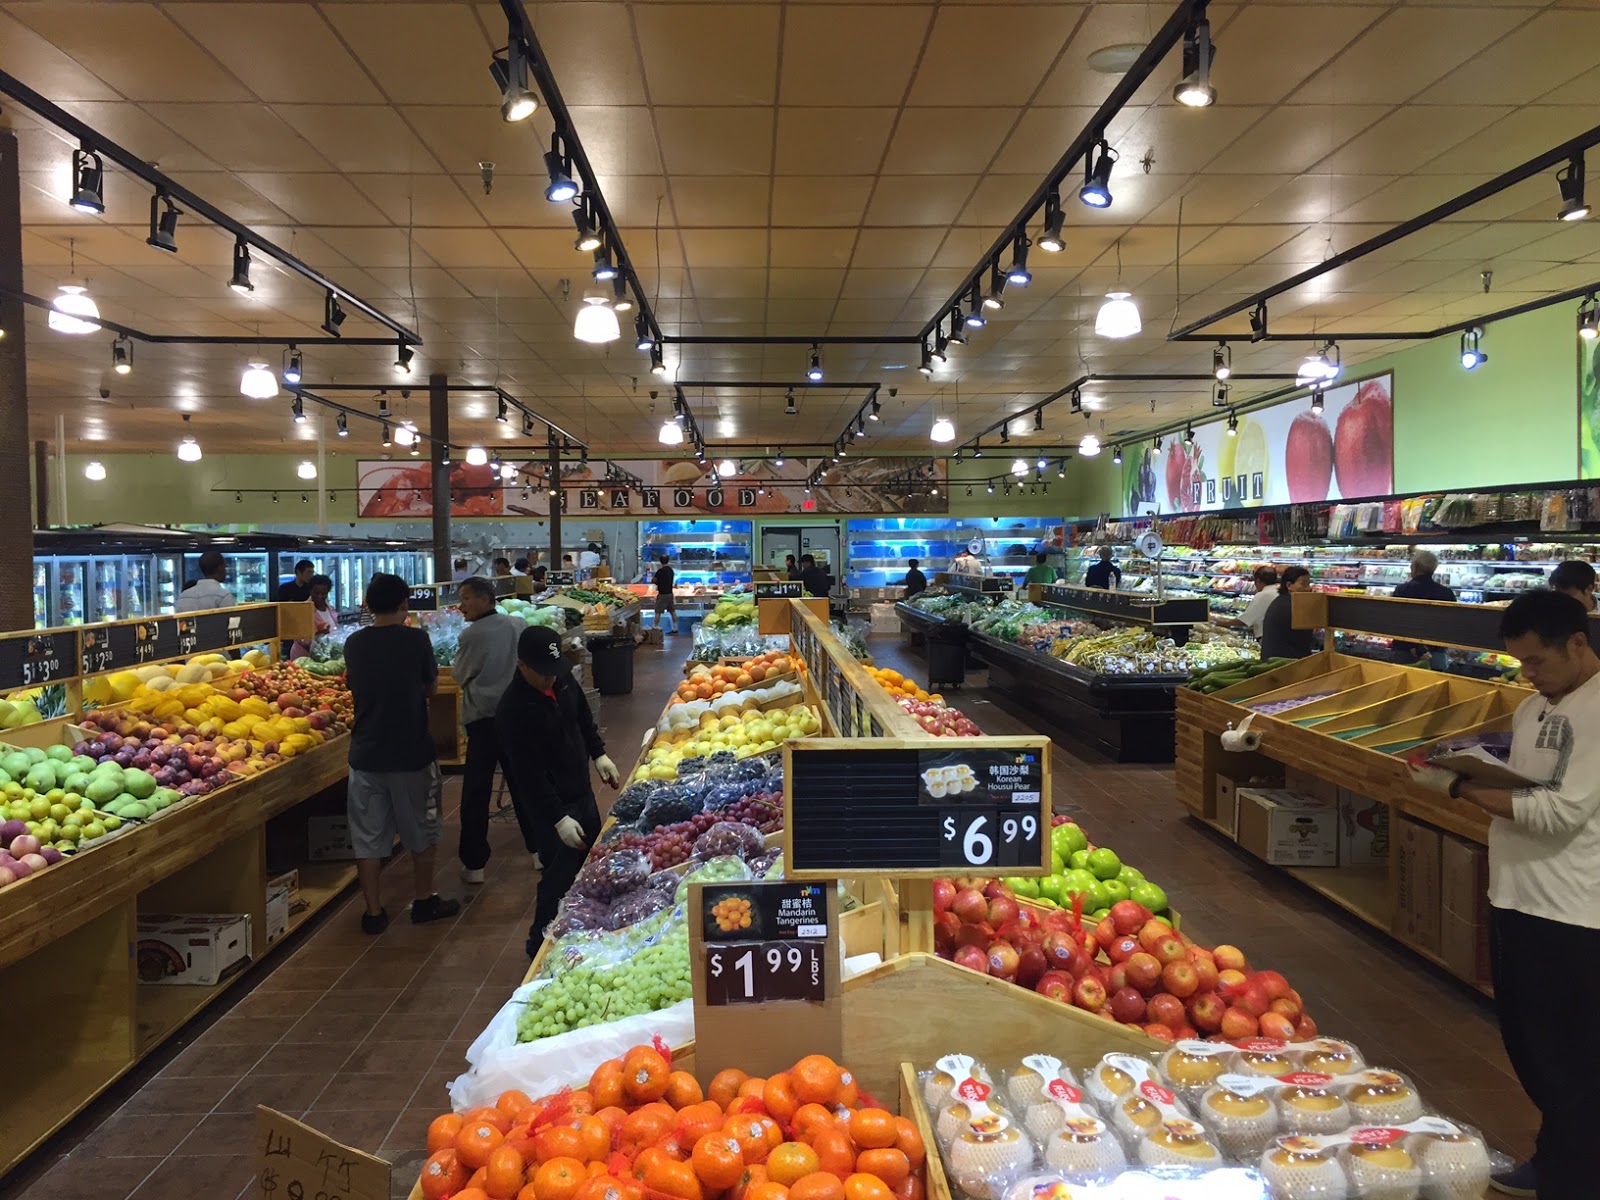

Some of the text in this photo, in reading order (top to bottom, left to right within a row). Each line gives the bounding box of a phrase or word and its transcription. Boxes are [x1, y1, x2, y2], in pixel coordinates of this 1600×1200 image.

[1194, 473, 1263, 503] FRUIT
[23, 663, 32, 685] 5
[996, 775, 1022, 783] Korean
[987, 783, 1014, 791] Housui
[777, 908, 816, 917] Mandarin
[775, 917, 819, 927] Tangerines
